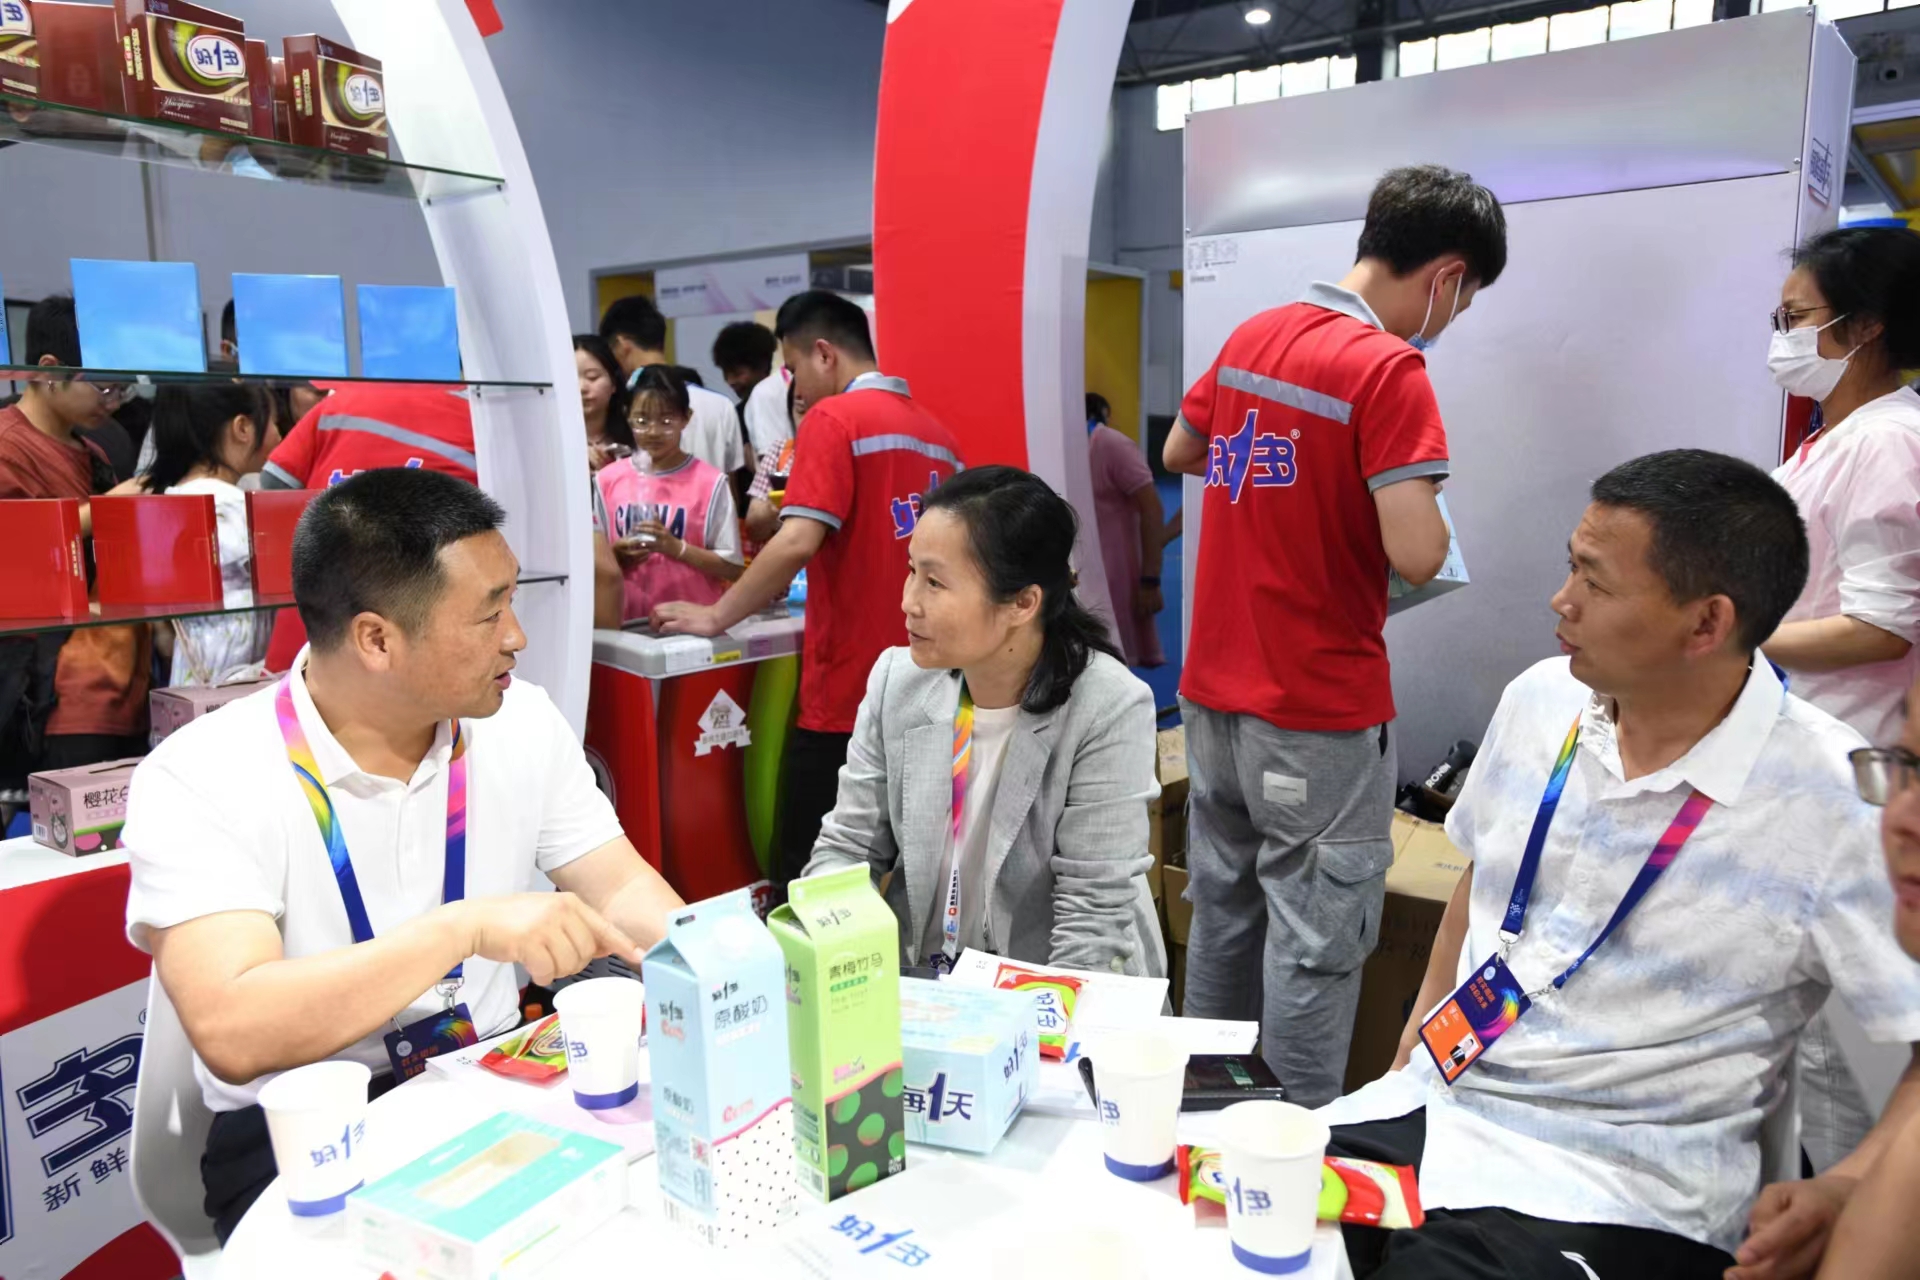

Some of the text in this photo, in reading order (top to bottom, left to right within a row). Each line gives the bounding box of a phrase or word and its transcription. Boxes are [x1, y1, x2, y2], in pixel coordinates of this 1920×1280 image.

[194, 41, 239, 71] 好1多
[350, 80, 380, 107] 好1多
[1424, 762, 1452, 788] RONIN
[714, 995, 768, 1030] 原酸奶
[903, 1071, 974, 1122] 每1天
[41, 1147, 129, 1213] 新鲜
[829, 1214, 931, 1267] 好1多
